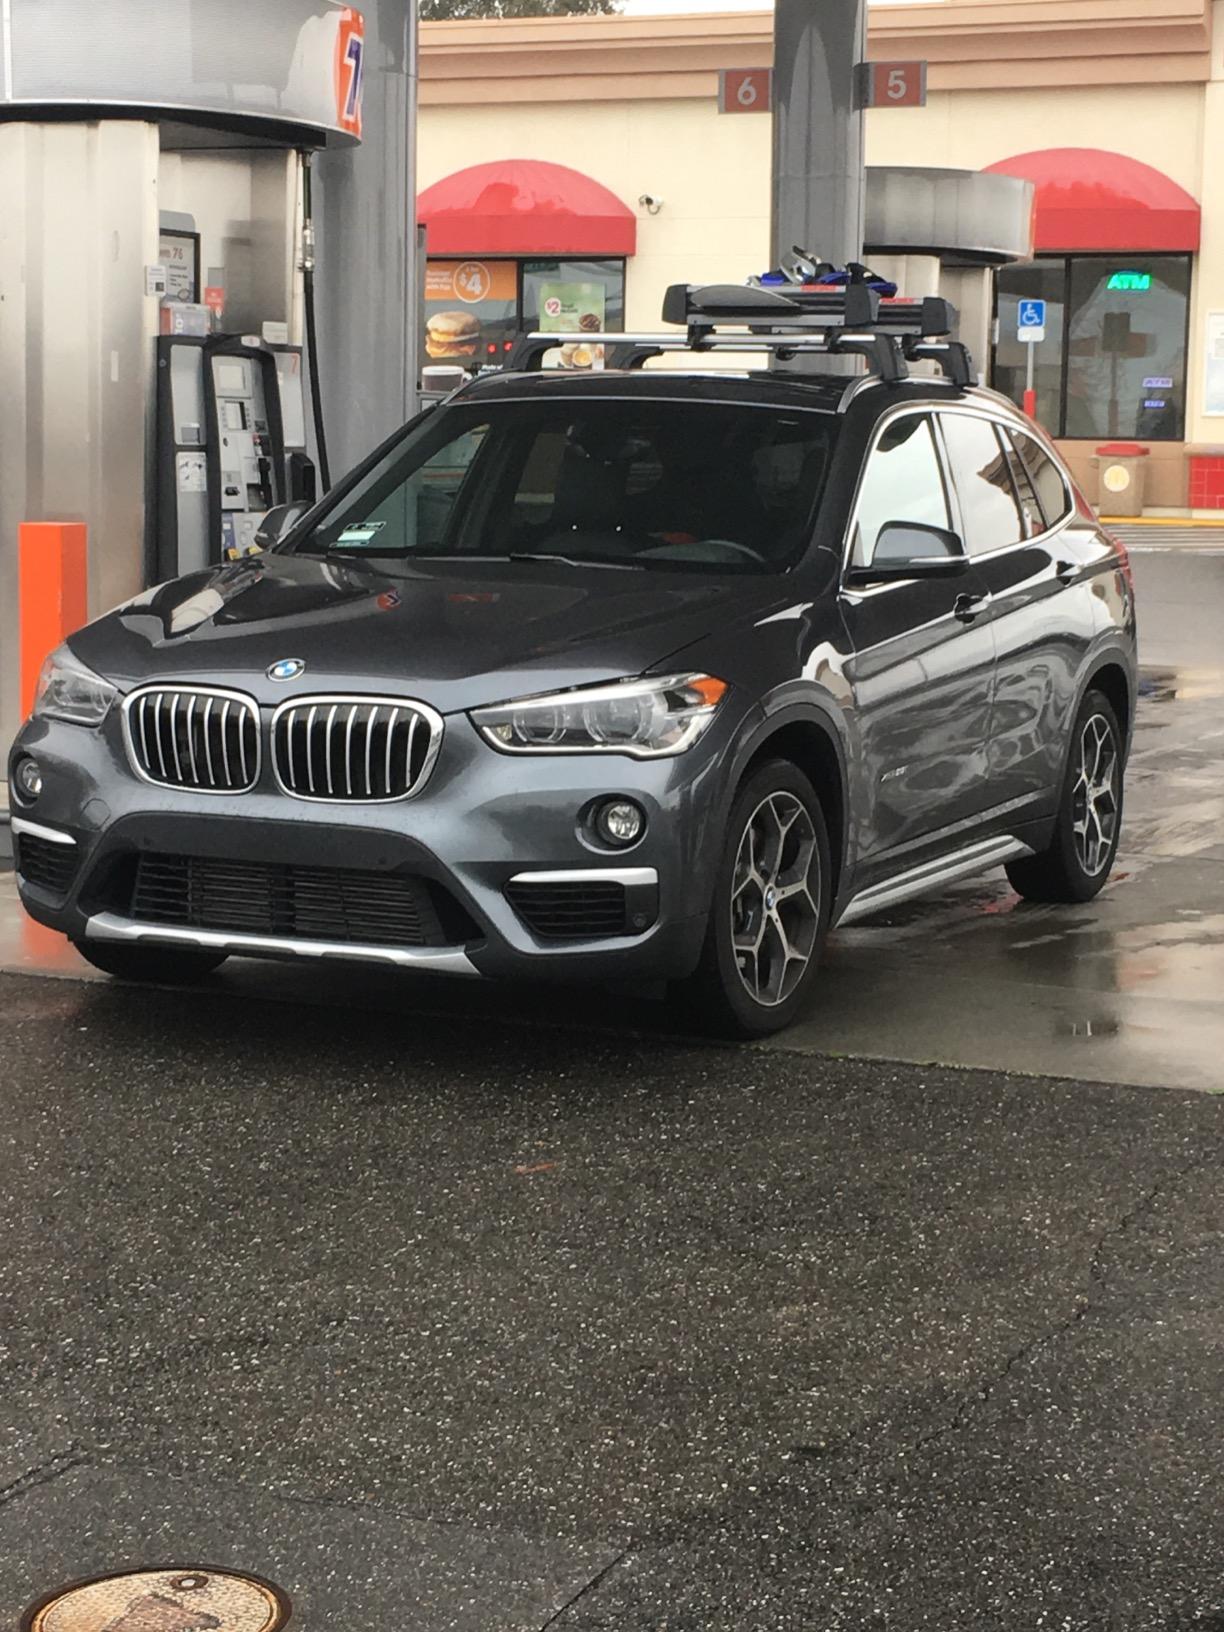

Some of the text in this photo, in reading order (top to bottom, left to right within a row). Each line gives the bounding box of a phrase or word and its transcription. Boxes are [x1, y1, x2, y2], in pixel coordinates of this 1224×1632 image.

[343, 32, 364, 121] 7
[887, 70, 907, 99] 5
[736, 76, 757, 106] 6
[459, 272, 482, 295] $4
[1107, 273, 1150, 290] ATM
[546, 300, 560, 314] $2
